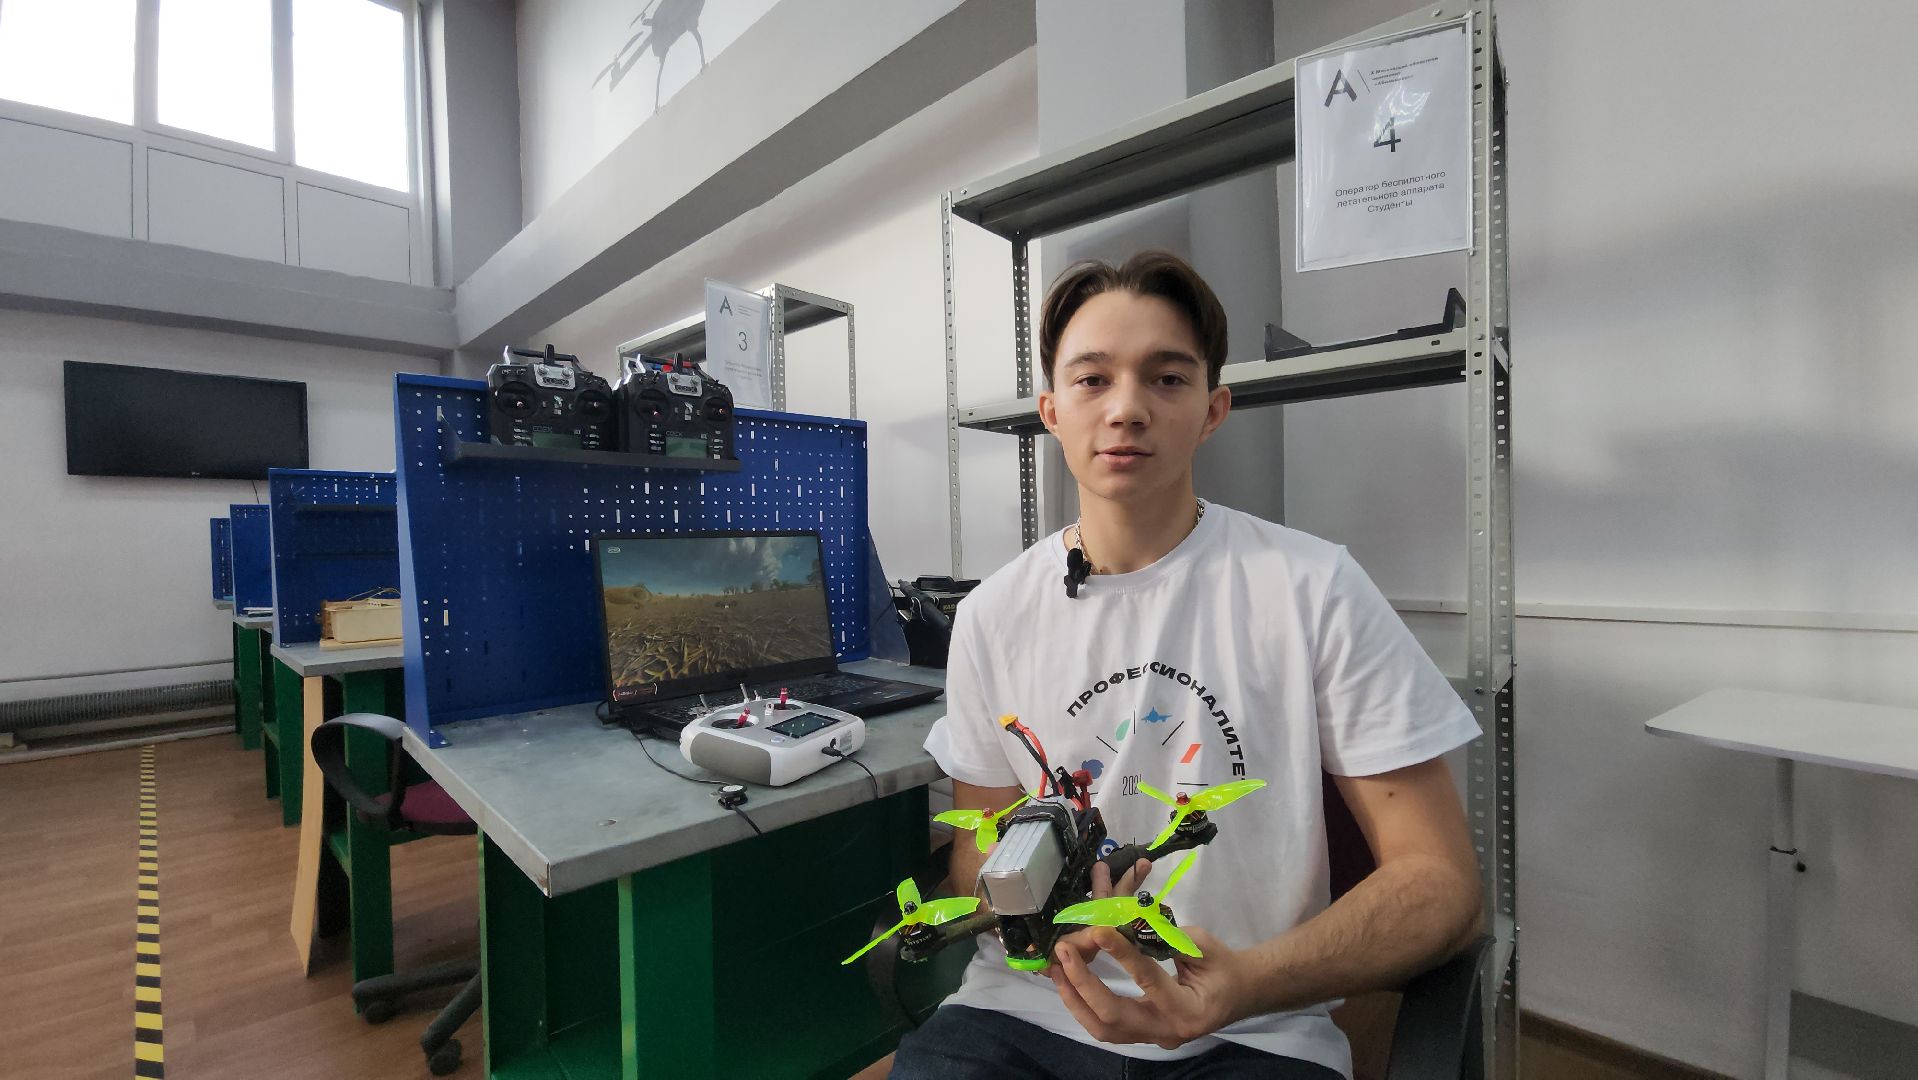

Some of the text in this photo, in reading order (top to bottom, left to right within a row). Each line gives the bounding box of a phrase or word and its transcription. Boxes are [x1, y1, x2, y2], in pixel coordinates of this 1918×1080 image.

[1373, 117, 1401, 152] 4
[1335, 171, 1446, 197] Оператор беспилотного
[1336, 182, 1445, 208] летательного аппарата
[738, 331, 748, 351] 3
[1066, 661, 1246, 781] ПРОФЕССИОНАЛИТЕ
